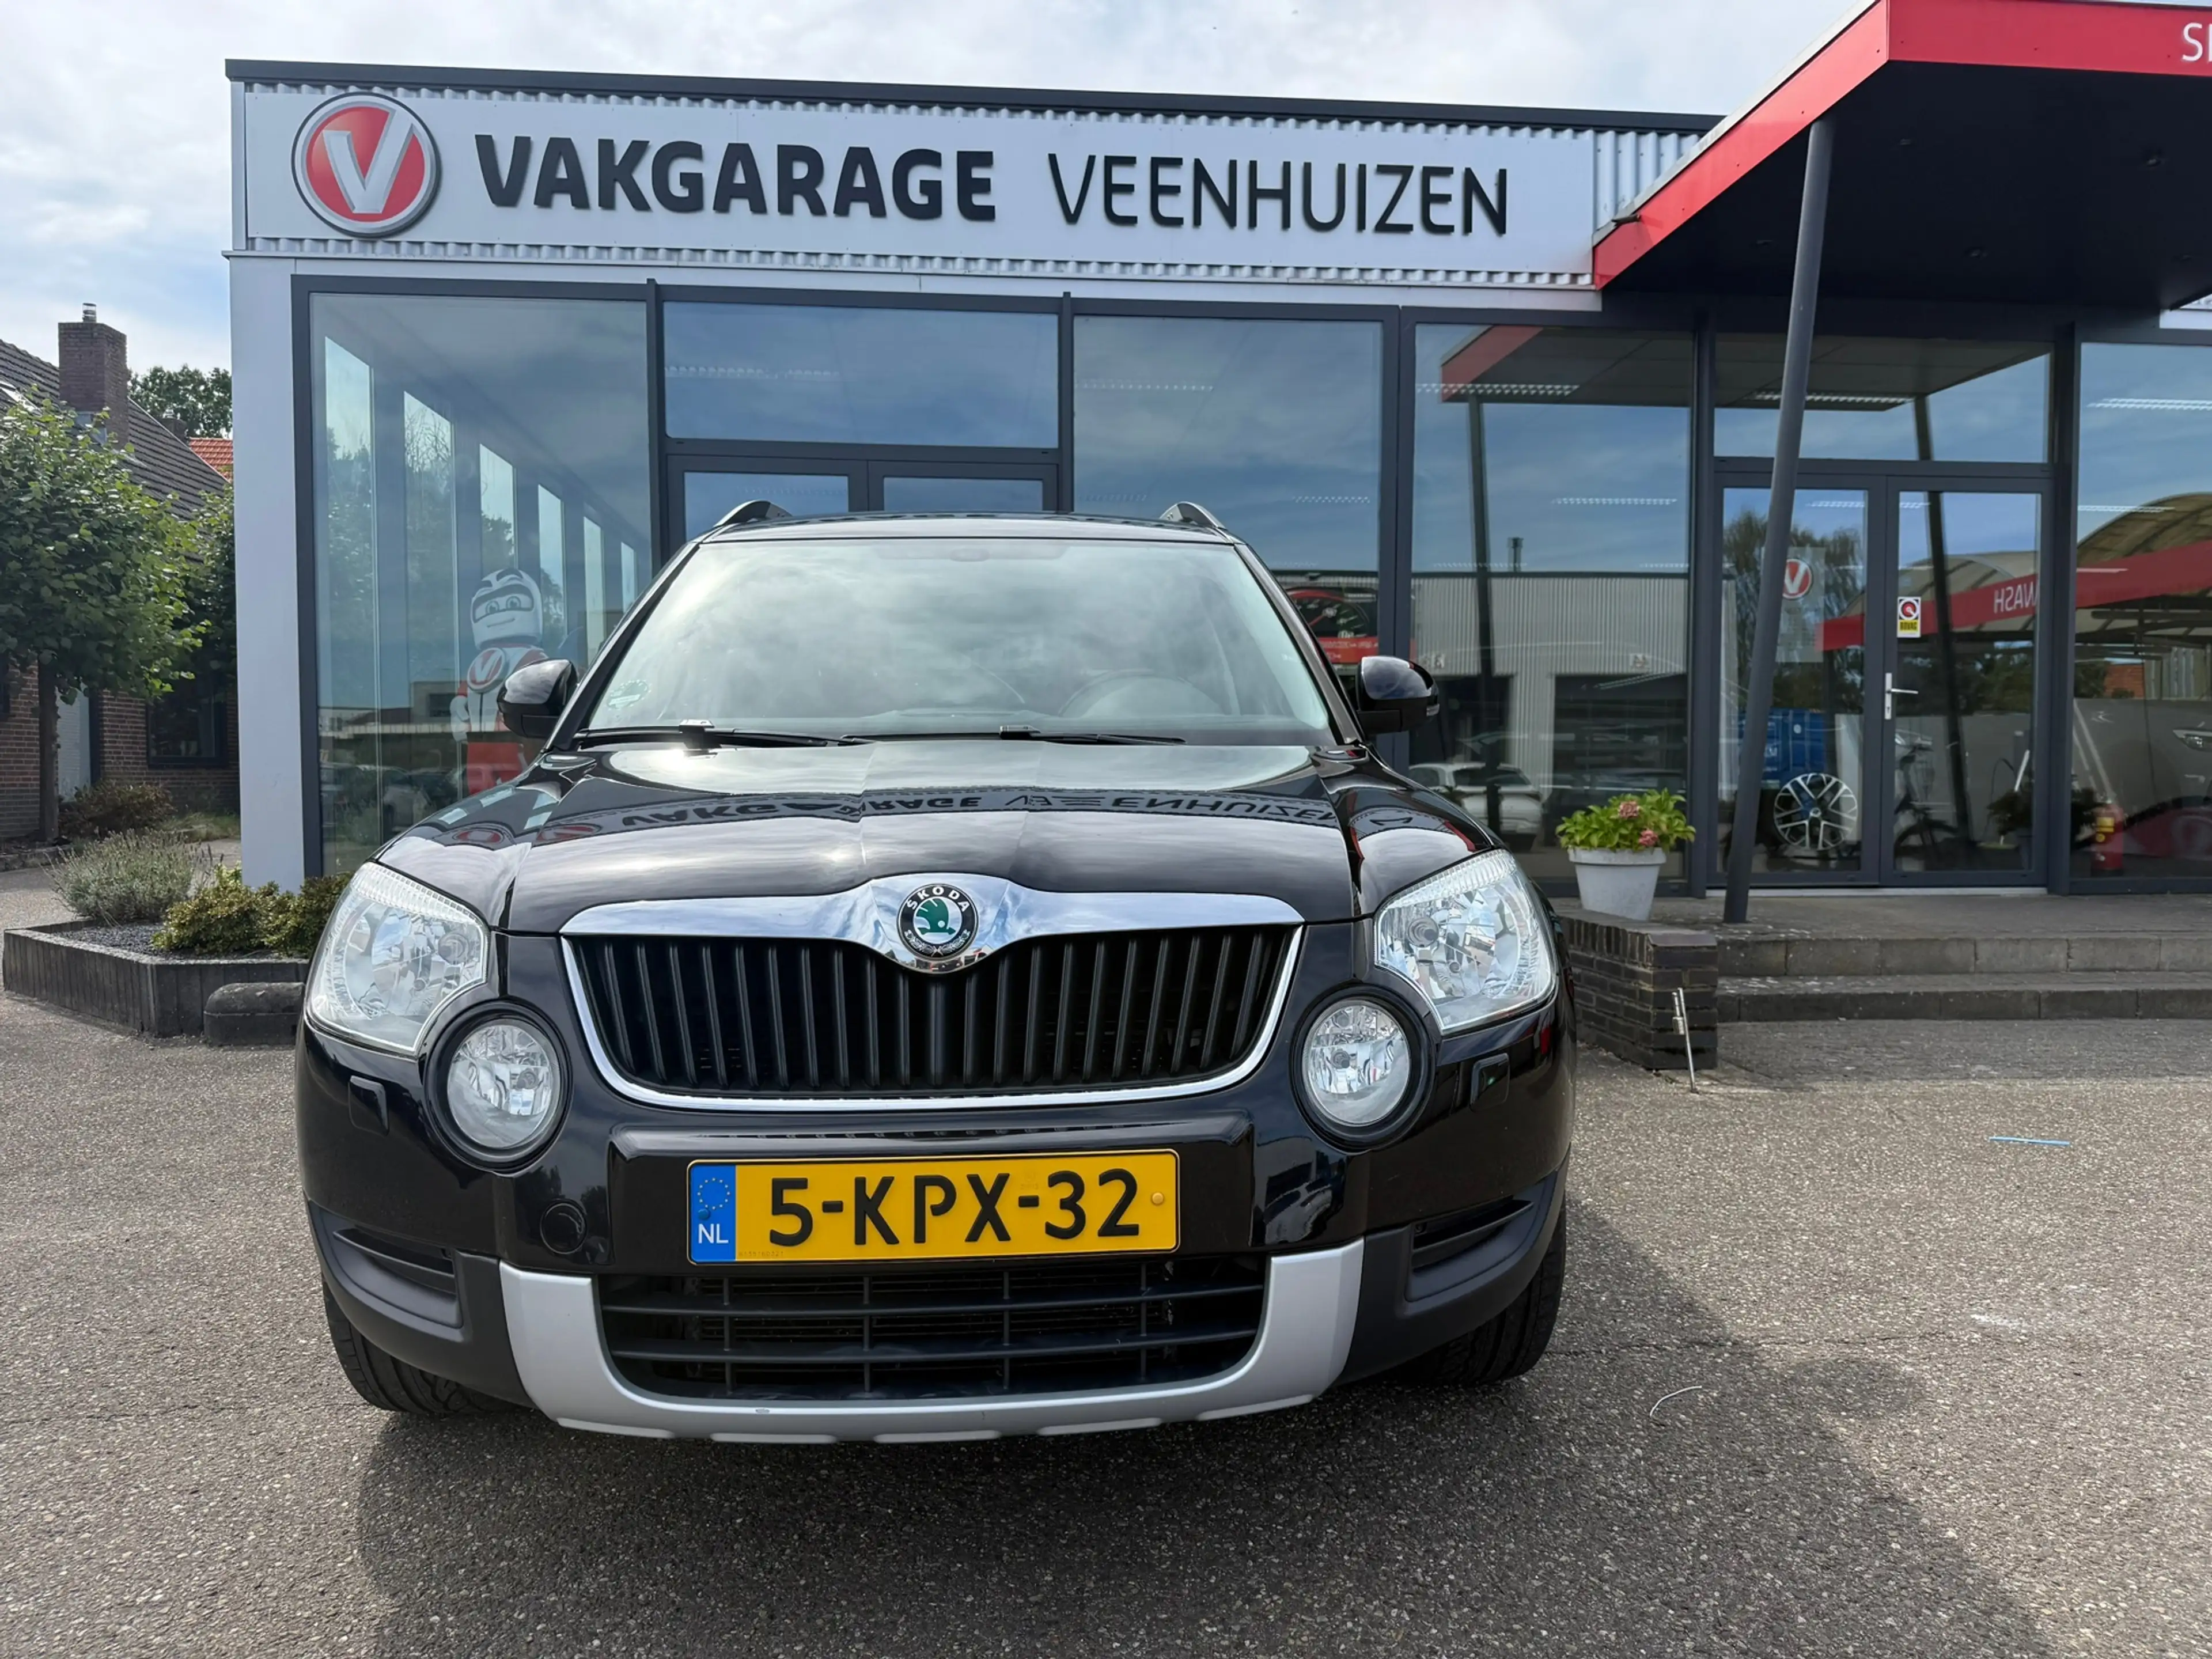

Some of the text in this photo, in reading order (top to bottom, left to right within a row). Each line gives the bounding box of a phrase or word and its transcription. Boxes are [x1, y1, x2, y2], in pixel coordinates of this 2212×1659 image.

[2181, 22, 2212, 63] S
[474, 134, 1508, 236] VAKGARAGE VEENHUIZEN
[697, 1224, 729, 1244] NL
[768, 1168, 1140, 1247] 5-KPX-32
